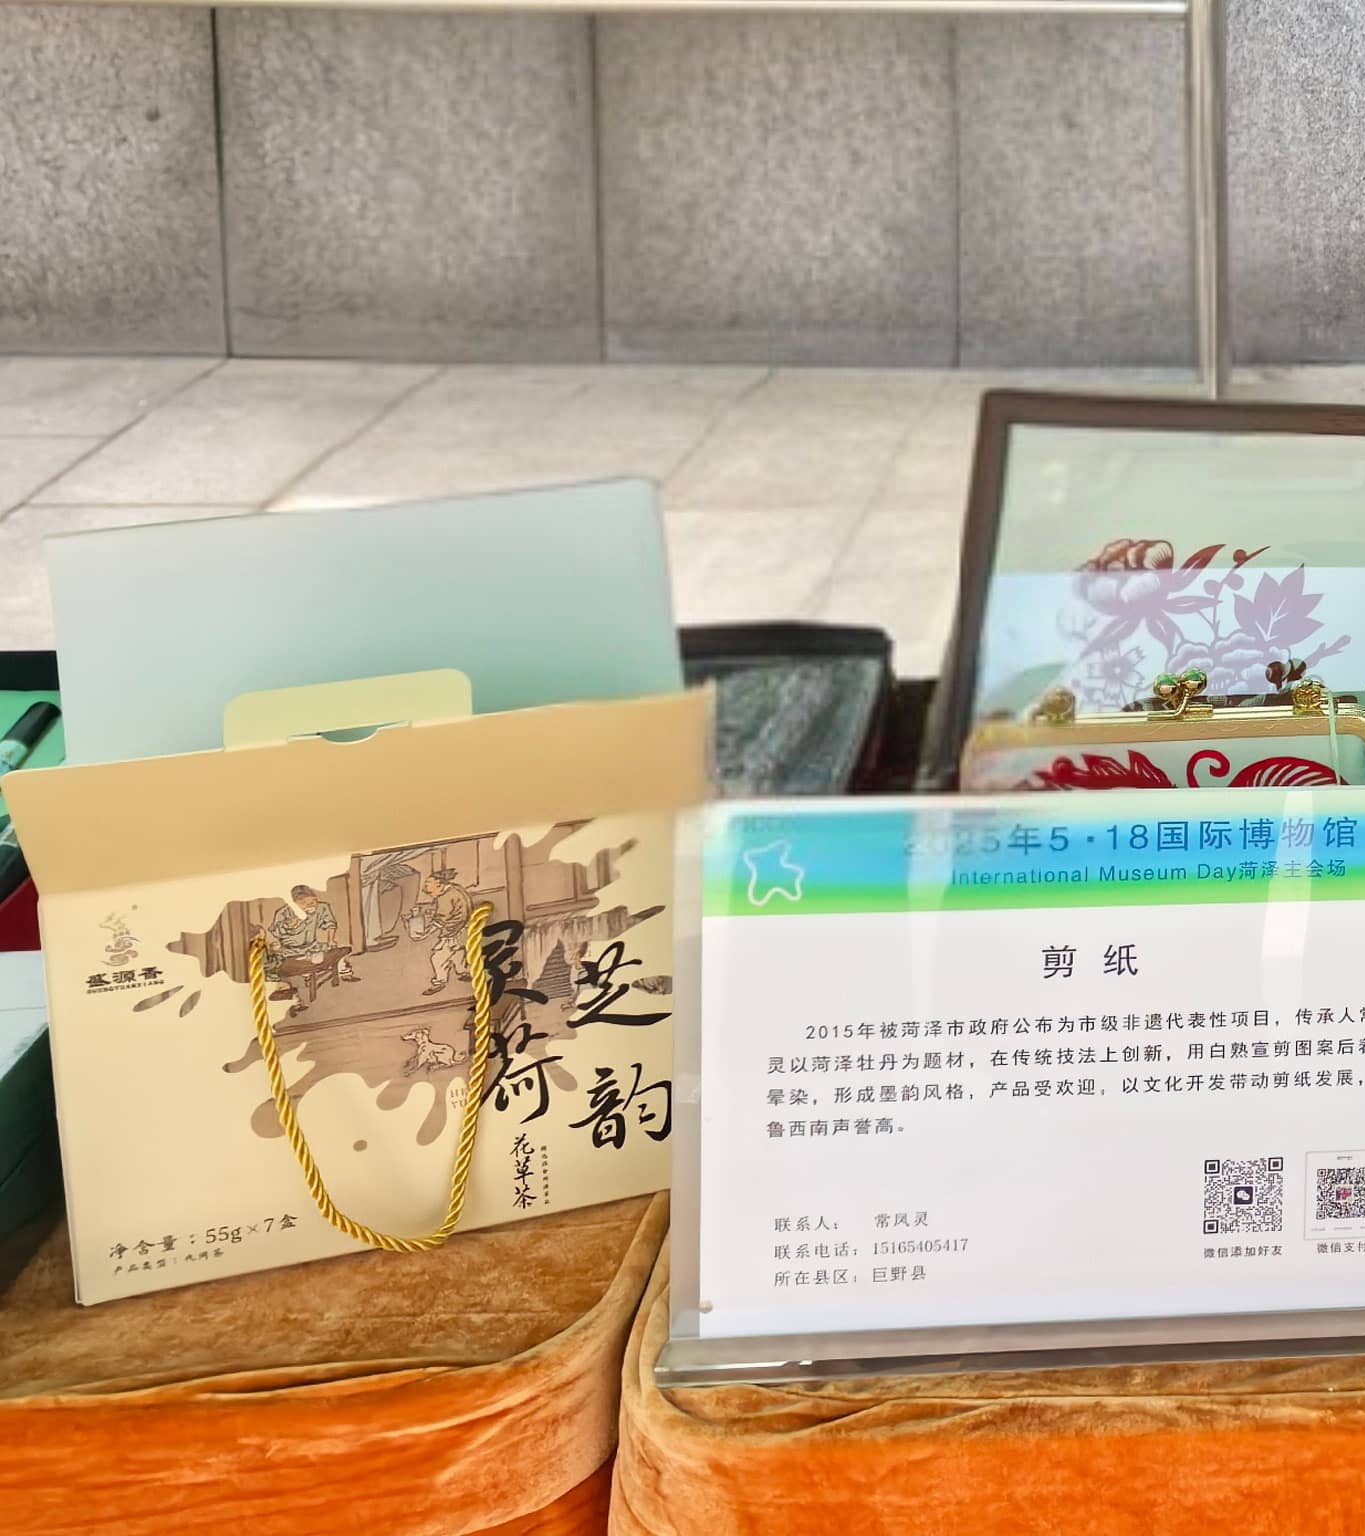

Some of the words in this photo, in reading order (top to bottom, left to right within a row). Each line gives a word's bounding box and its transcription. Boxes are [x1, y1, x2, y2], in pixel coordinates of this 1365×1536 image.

[951, 864, 1088, 886] International
[1099, 864, 1187, 882] Museum
[1042, 944, 1139, 981] 剪纸
[767, 1117, 904, 1138] 鲁西南声誉高。
[510, 1133, 536, 1209] 花草茶
[774, 1215, 840, 1232] 联系人：
[874, 1211, 929, 1228] 常凤灵
[774, 1242, 858, 1260] 联系电话：
[873, 1238, 969, 1256] 15165405417
[774, 1268, 858, 1287] 所在县区：
[872, 1265, 927, 1283] 巨野县
